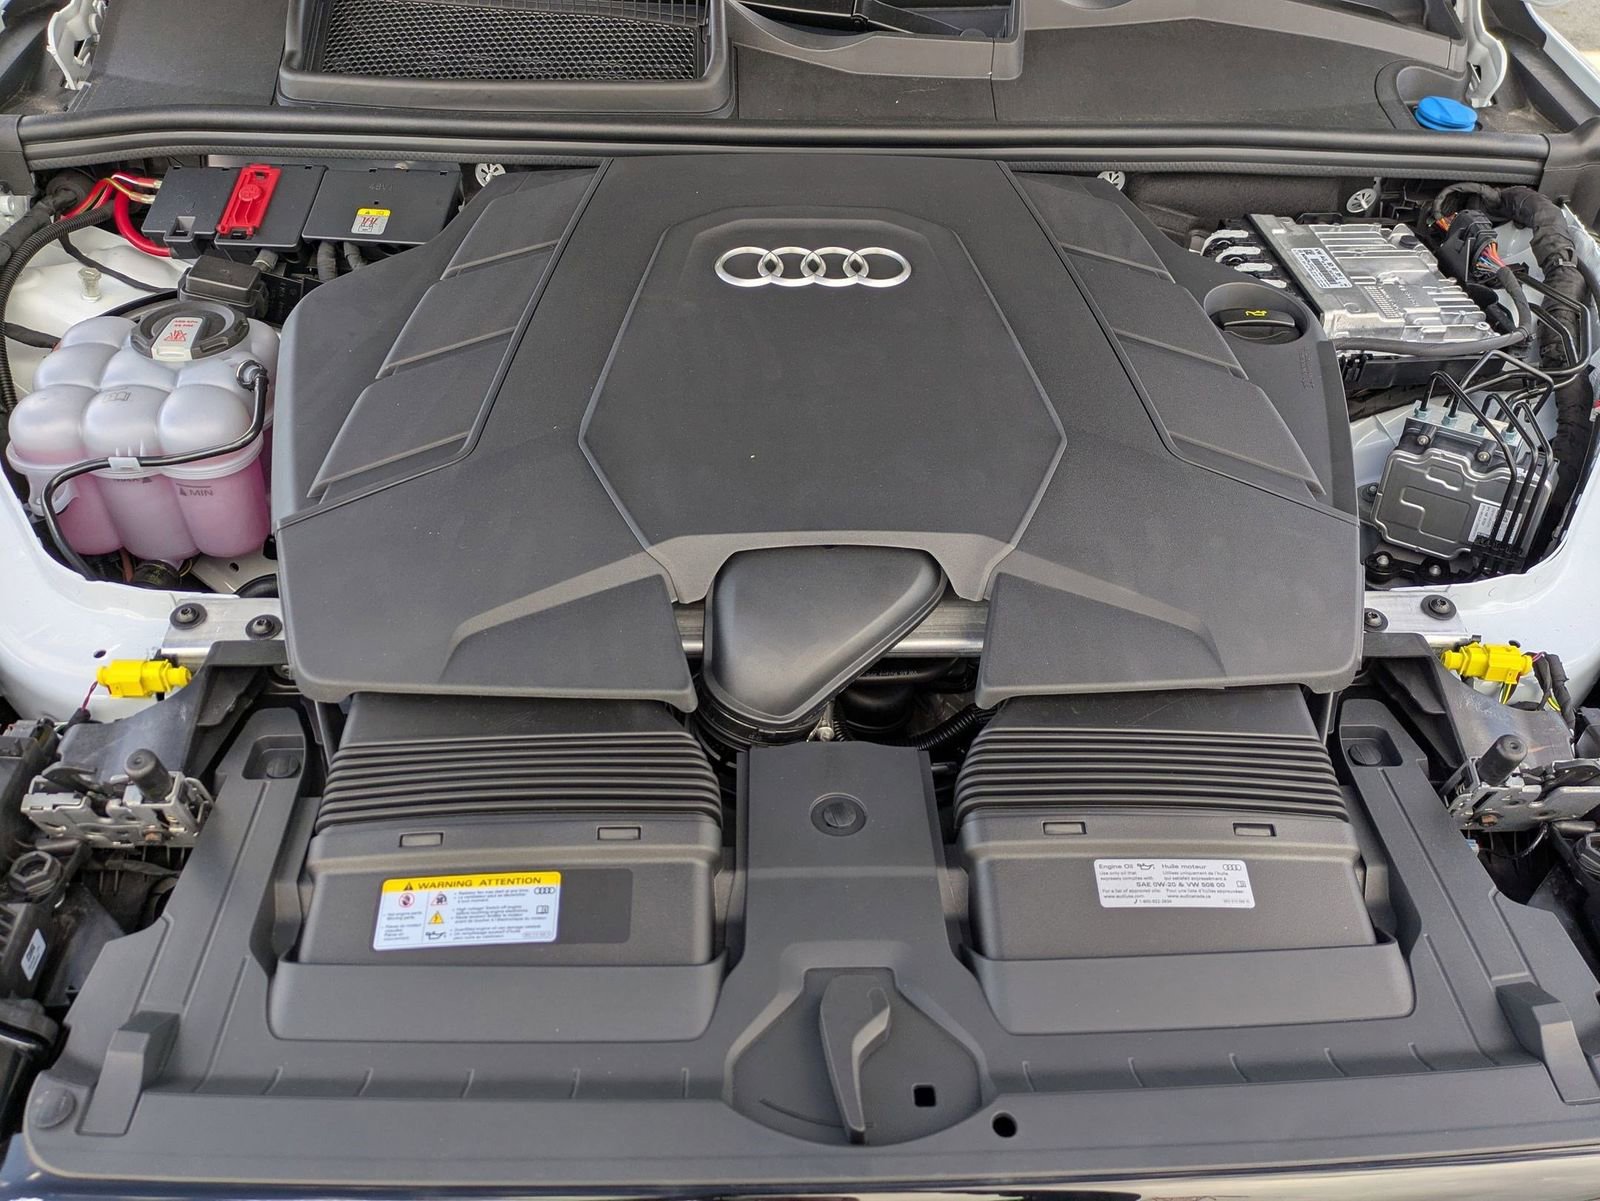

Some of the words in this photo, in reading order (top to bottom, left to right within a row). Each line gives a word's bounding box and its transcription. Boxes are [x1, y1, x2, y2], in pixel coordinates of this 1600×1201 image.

[189, 489, 213, 497] MIN
[417, 880, 473, 890] WARNING
[478, 877, 542, 887] ATTENTION
